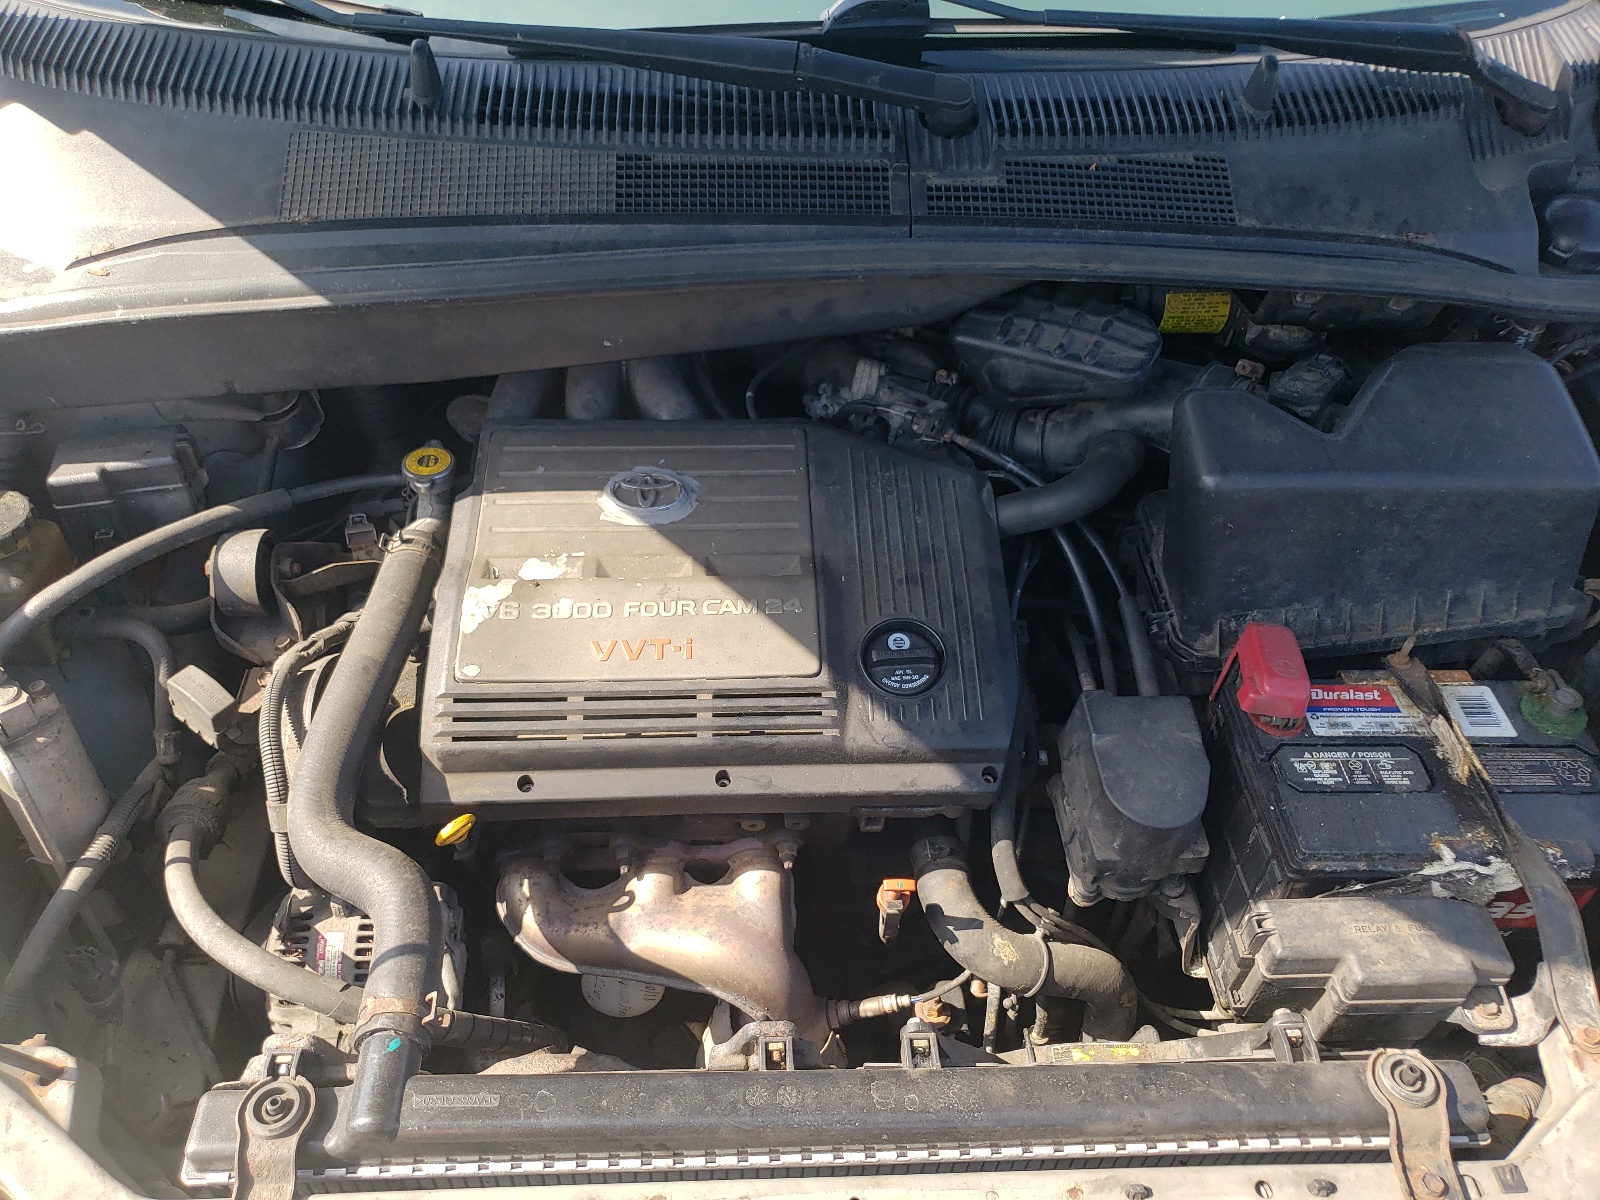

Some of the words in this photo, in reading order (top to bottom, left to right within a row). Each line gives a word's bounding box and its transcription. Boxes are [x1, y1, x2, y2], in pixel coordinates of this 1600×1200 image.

[531, 602, 613, 619] 3000
[623, 601, 697, 618] FOUR
[702, 600, 758, 615] CAM
[765, 599, 803, 614] 24
[882, 677, 900, 688] ENERGY
[901, 674, 929, 688] CONSERVING
[1311, 688, 1381, 700] Duralast
[1353, 924, 1387, 934] RELAY
[1408, 924, 1436, 932] FUSE
